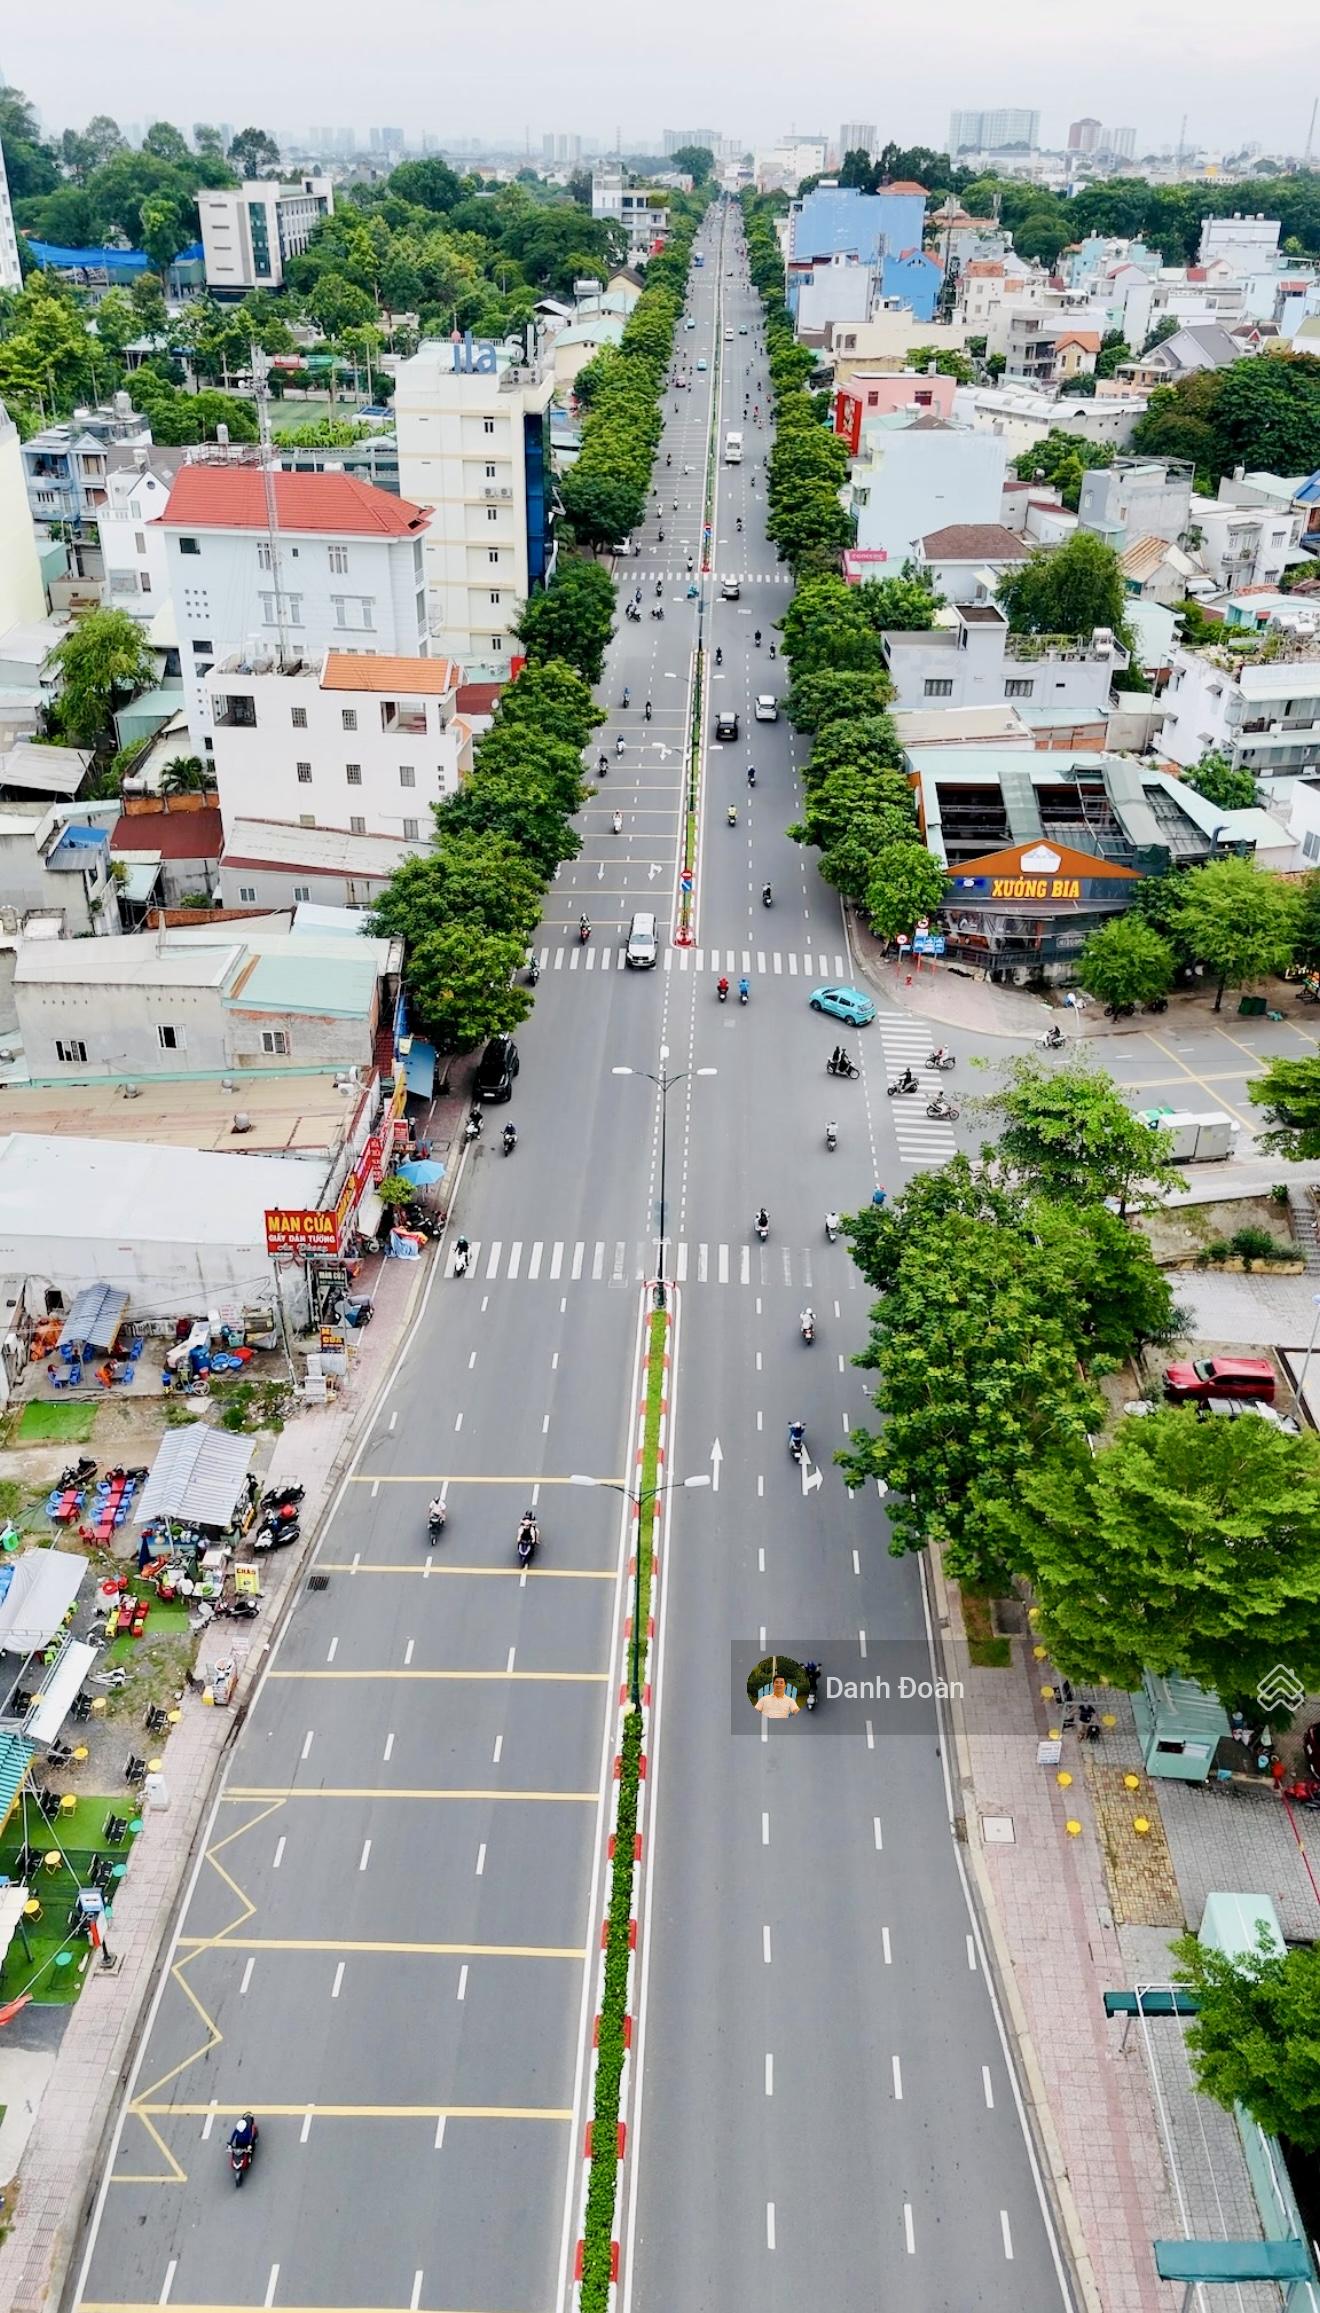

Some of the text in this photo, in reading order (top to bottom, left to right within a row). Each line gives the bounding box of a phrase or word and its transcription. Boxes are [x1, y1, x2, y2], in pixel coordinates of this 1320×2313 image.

[451, 330, 496, 374] ila
[1051, 880, 1080, 898] BIA
[267, 1211, 334, 1233] MÀN CỬA
